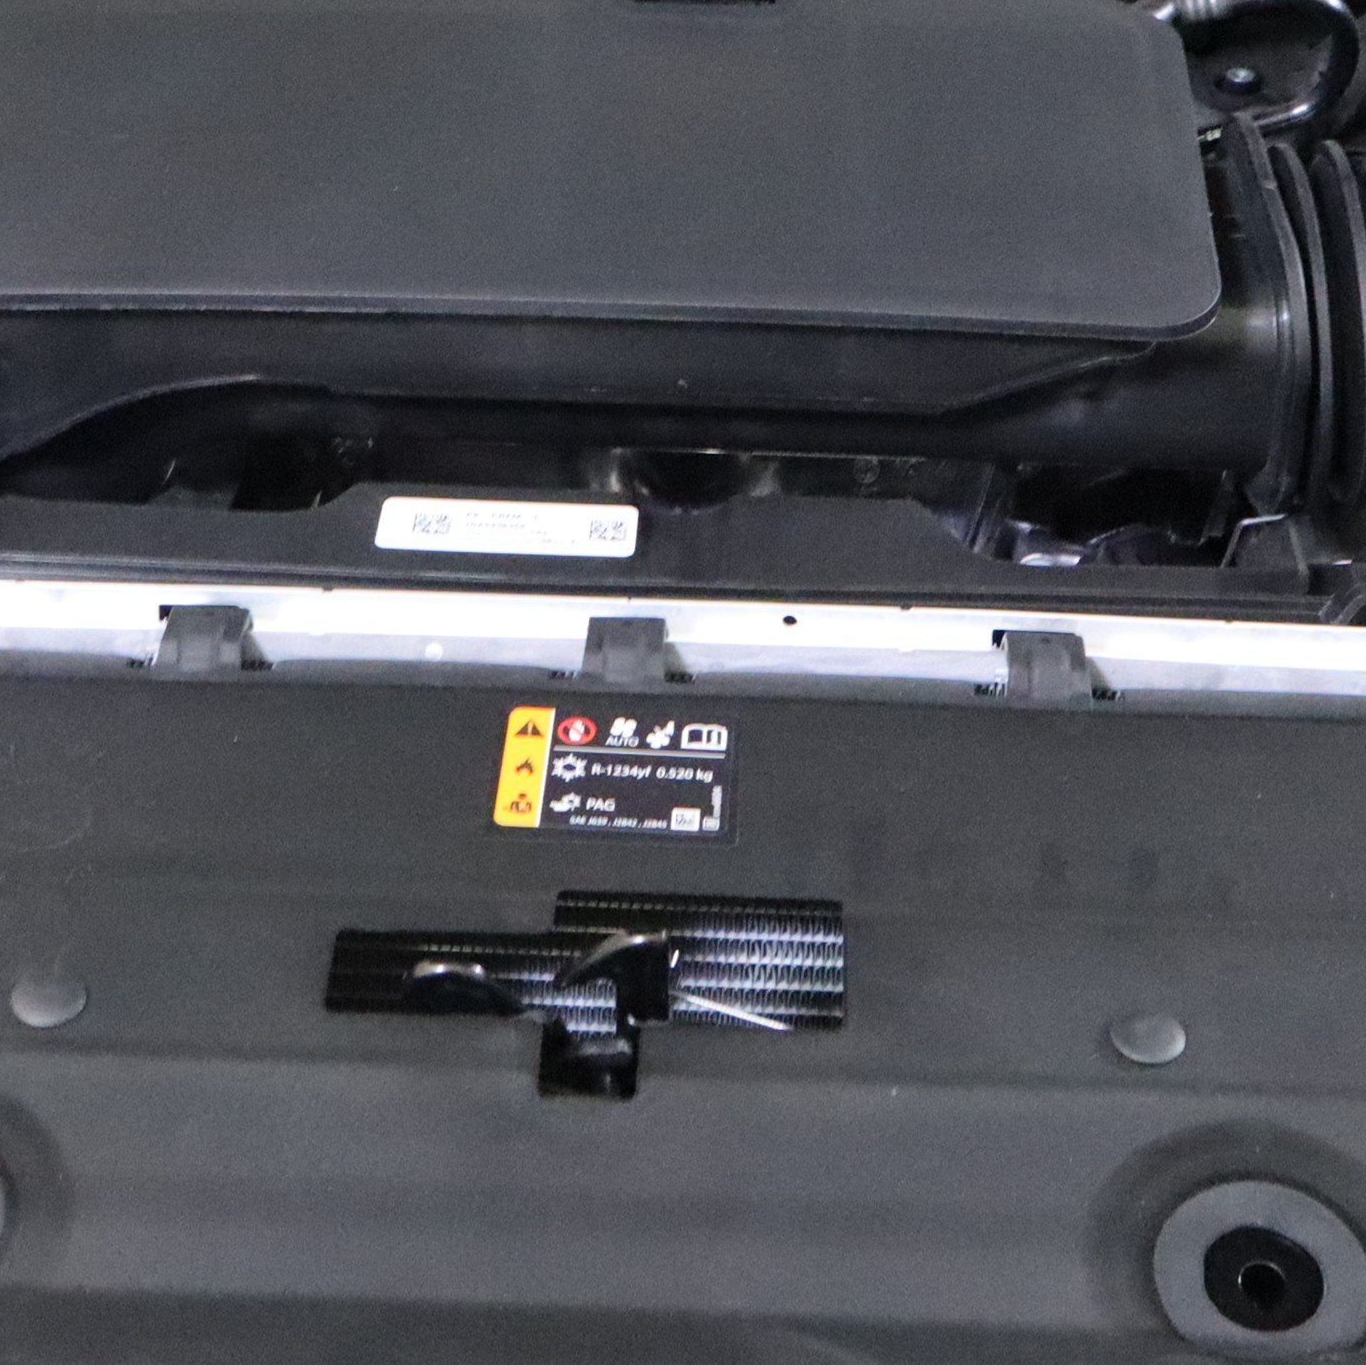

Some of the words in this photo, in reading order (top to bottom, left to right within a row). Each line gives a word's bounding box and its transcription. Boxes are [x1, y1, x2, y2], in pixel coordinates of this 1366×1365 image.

[605, 736, 640, 748] AUTO
[591, 763, 652, 780] R-1234yf
[656, 766, 694, 781] 0.520
[696, 768, 714, 783] kg
[586, 797, 616, 812] PAG
